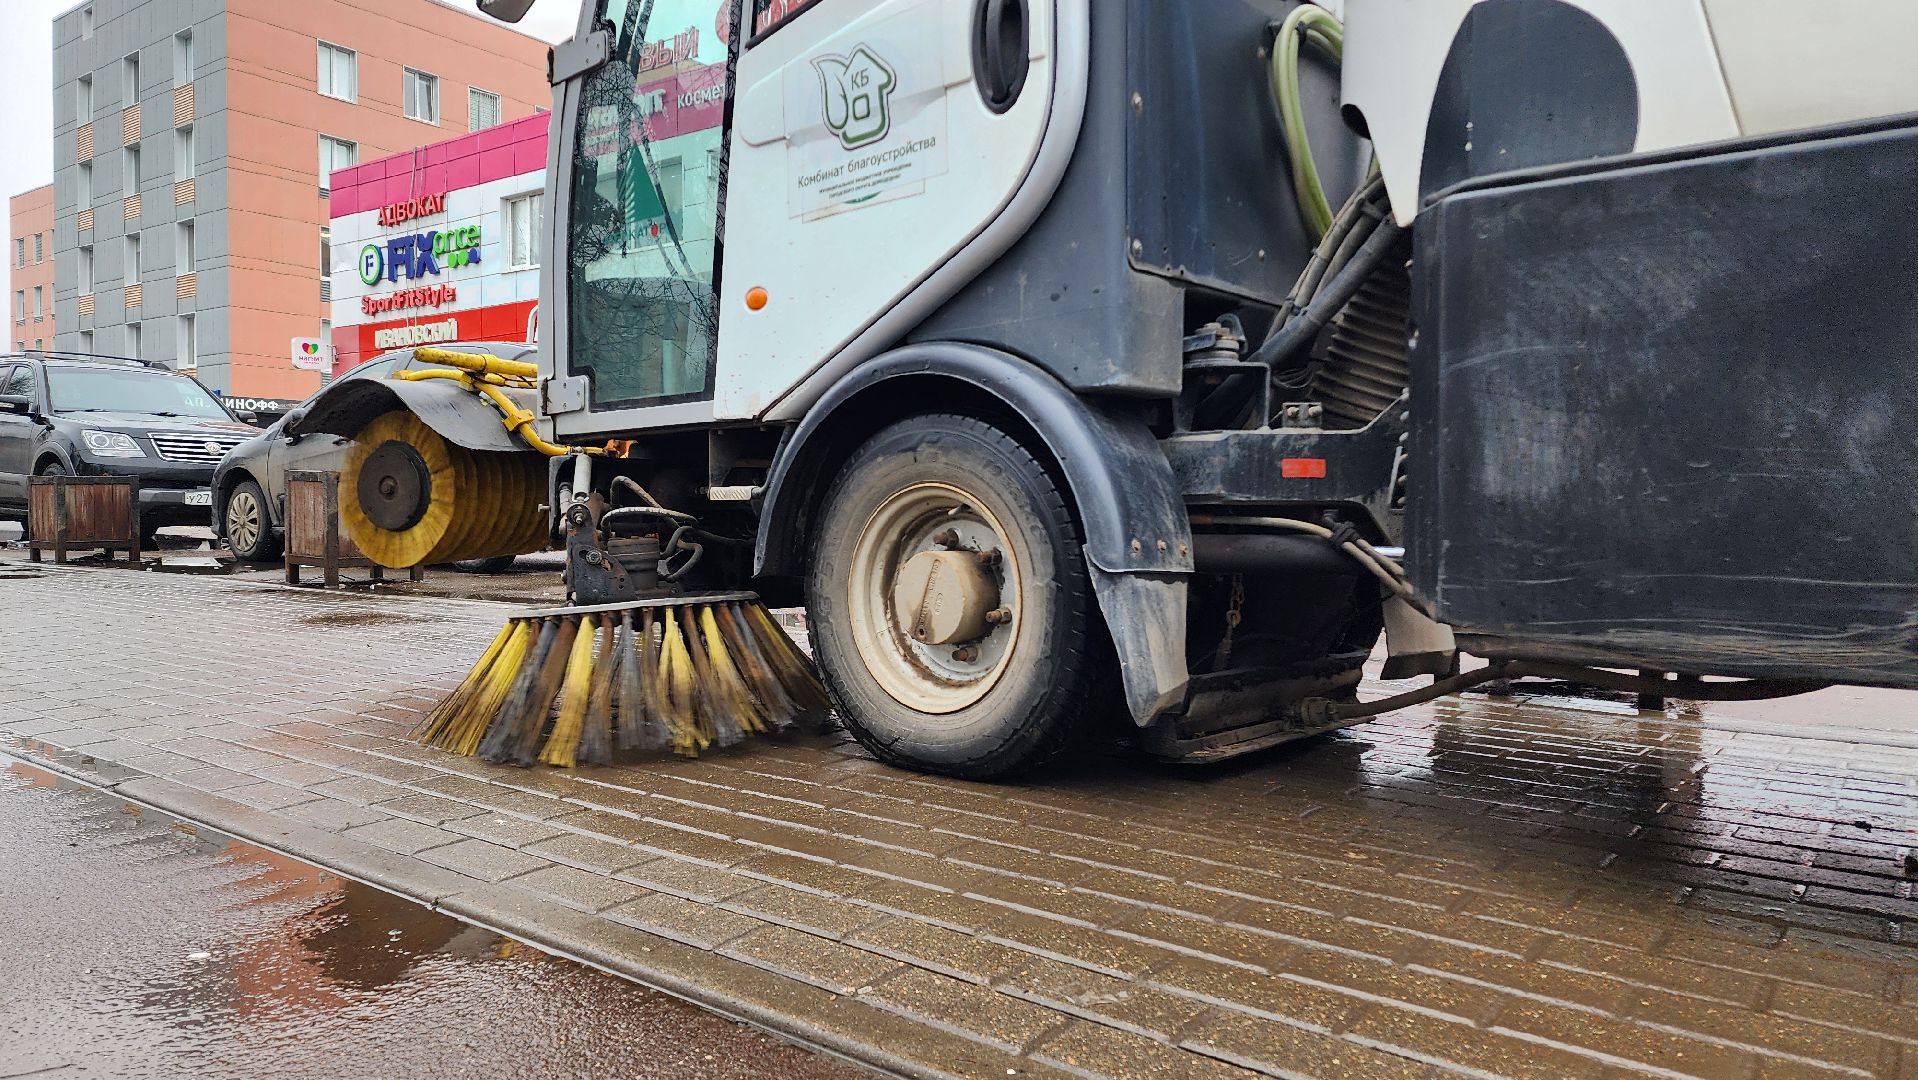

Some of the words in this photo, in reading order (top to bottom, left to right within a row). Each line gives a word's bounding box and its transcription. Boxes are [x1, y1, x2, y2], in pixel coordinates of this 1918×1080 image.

[851, 69, 870, 91] КБ
[798, 164, 845, 189] Комбинат
[847, 136, 936, 173] благоустройства
[377, 191, 447, 227] АДВОКАТ
[361, 284, 456, 317] SportFitStyle
[375, 318, 458, 349] ИВАНОВСКИЙ
